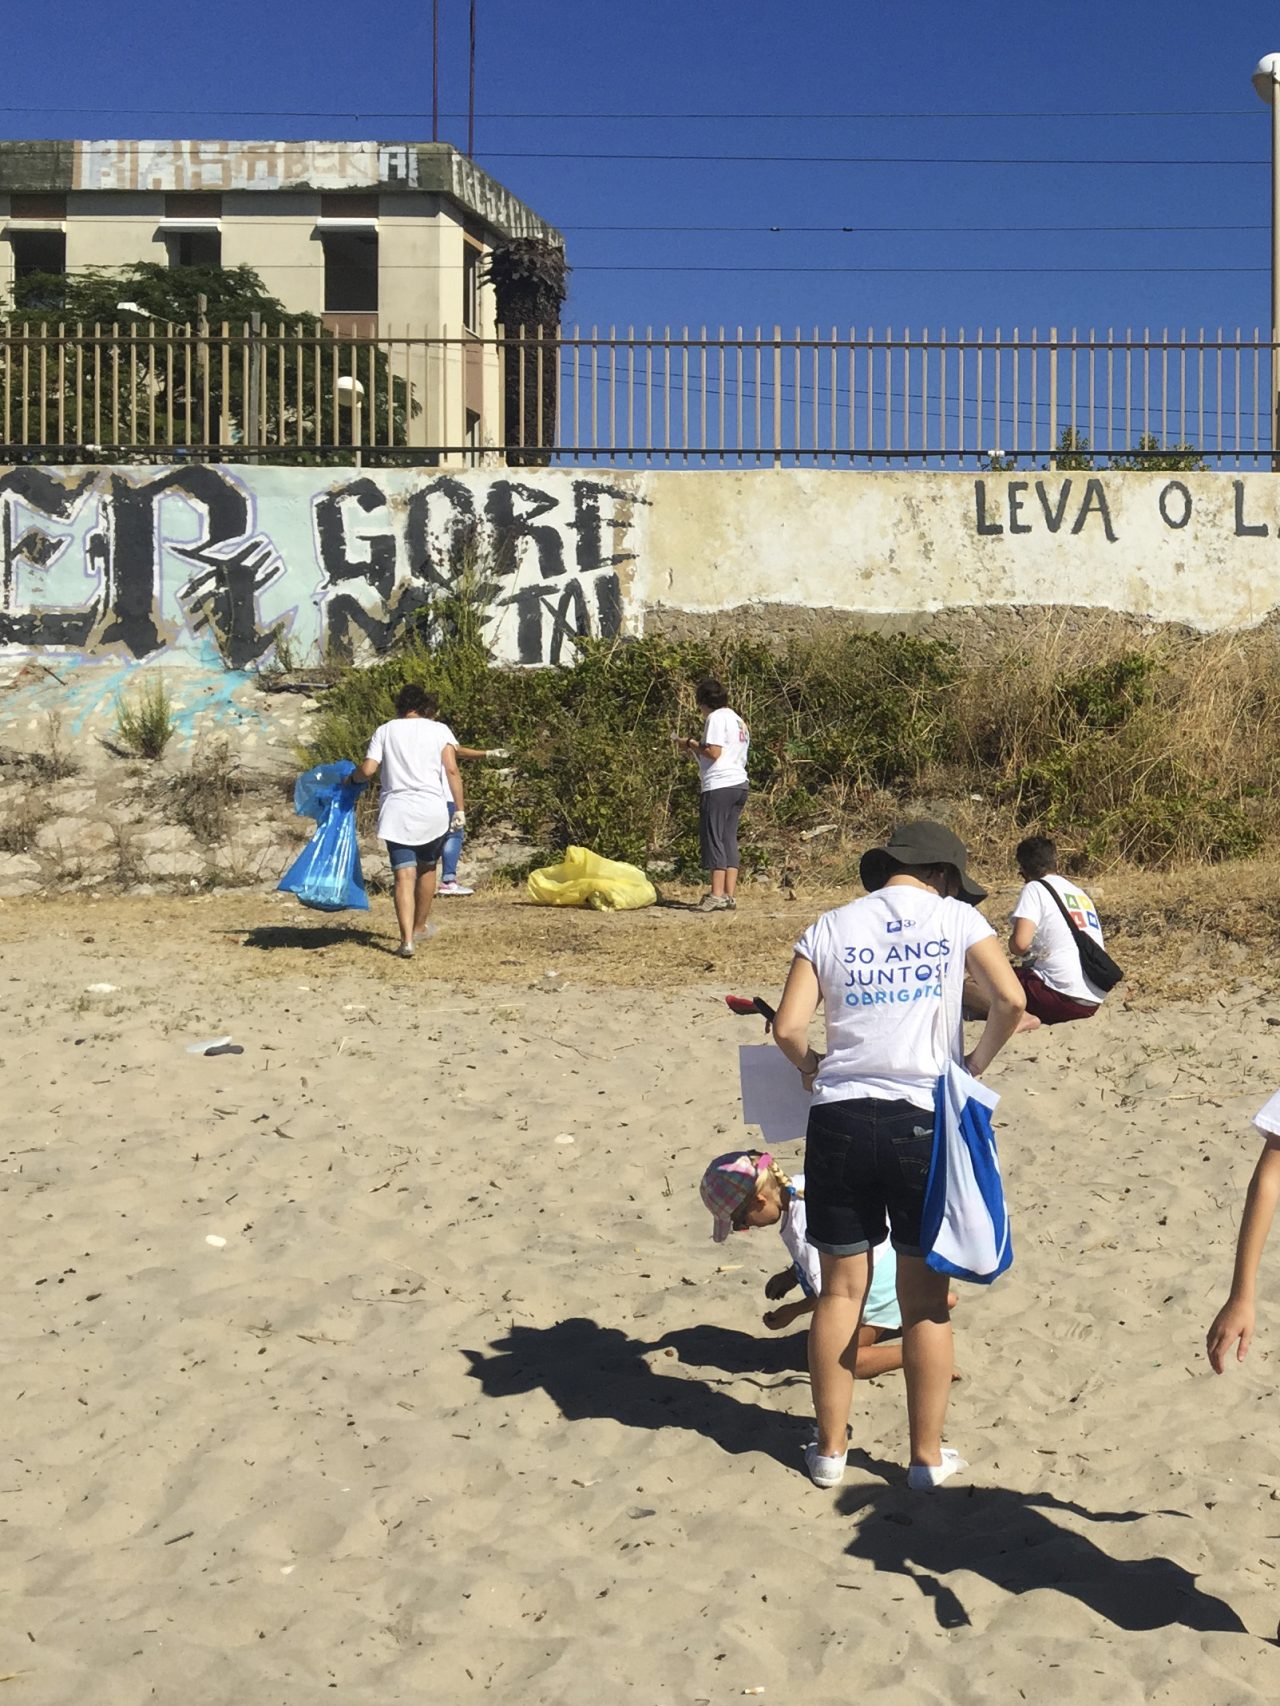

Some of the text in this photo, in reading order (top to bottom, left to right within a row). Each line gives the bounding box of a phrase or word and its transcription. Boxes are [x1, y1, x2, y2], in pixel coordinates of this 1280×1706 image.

[315, 474, 653, 600] GORE
[974, 478, 1119, 543] LEVA
[1159, 480, 1193, 530] O
[843, 938, 951, 964] 30 ANOS
